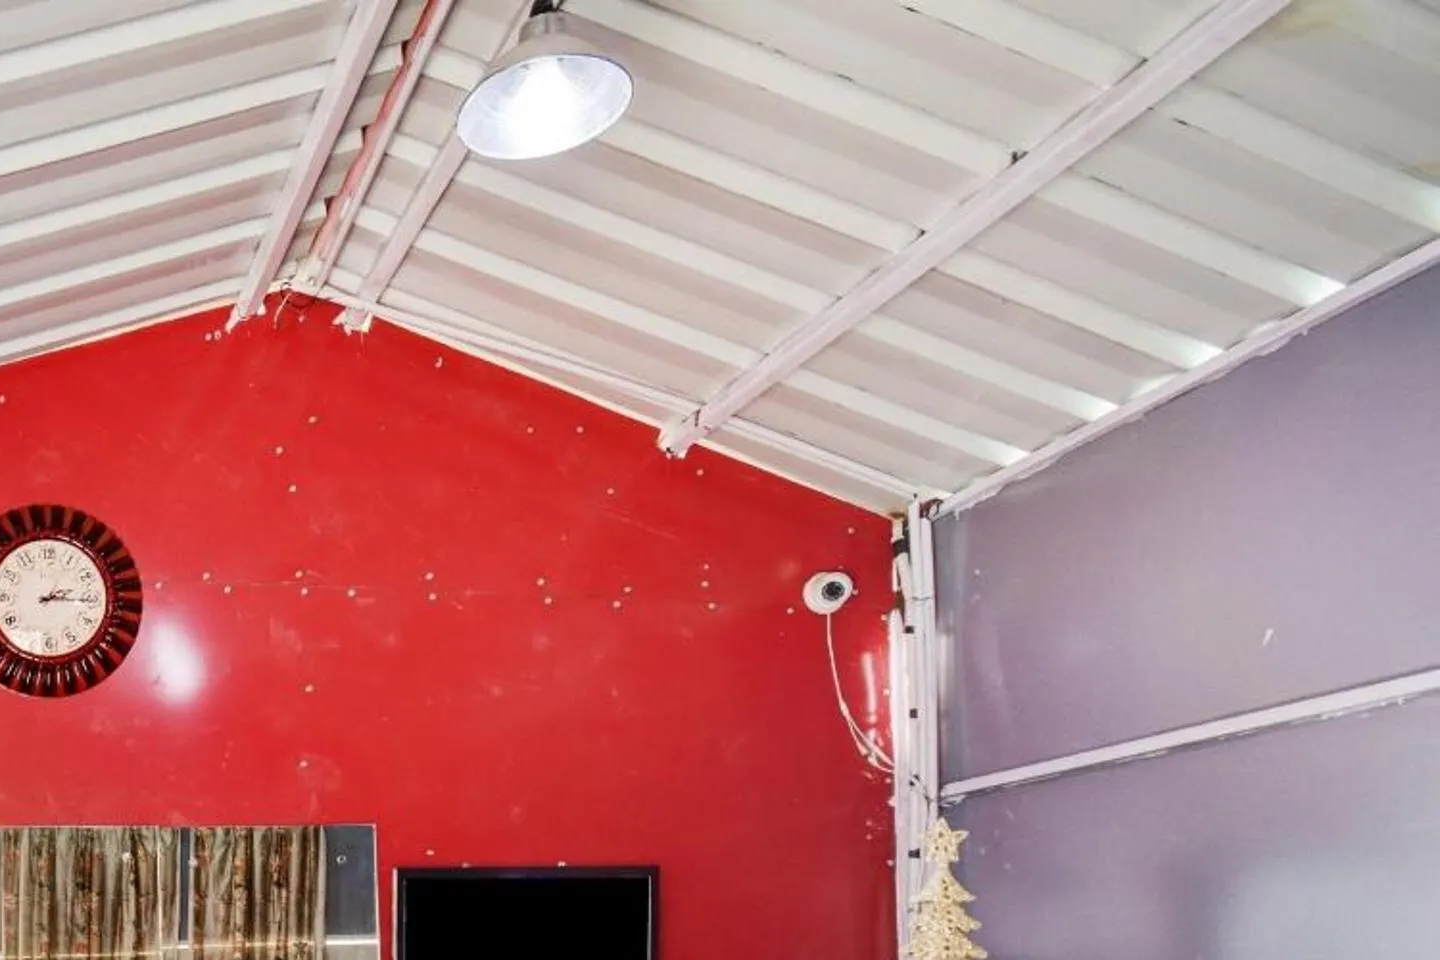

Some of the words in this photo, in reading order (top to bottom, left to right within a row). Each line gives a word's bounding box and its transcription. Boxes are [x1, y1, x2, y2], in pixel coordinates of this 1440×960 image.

[20, 552, 33, 567] 11
[43, 548, 56, 560] 12
[4, 568, 16, 582] 10
[80, 571, 92, 582] 2
[5, 615, 16, 627] 8
[64, 631, 76, 642] 5
[44, 637, 54, 650] 6
